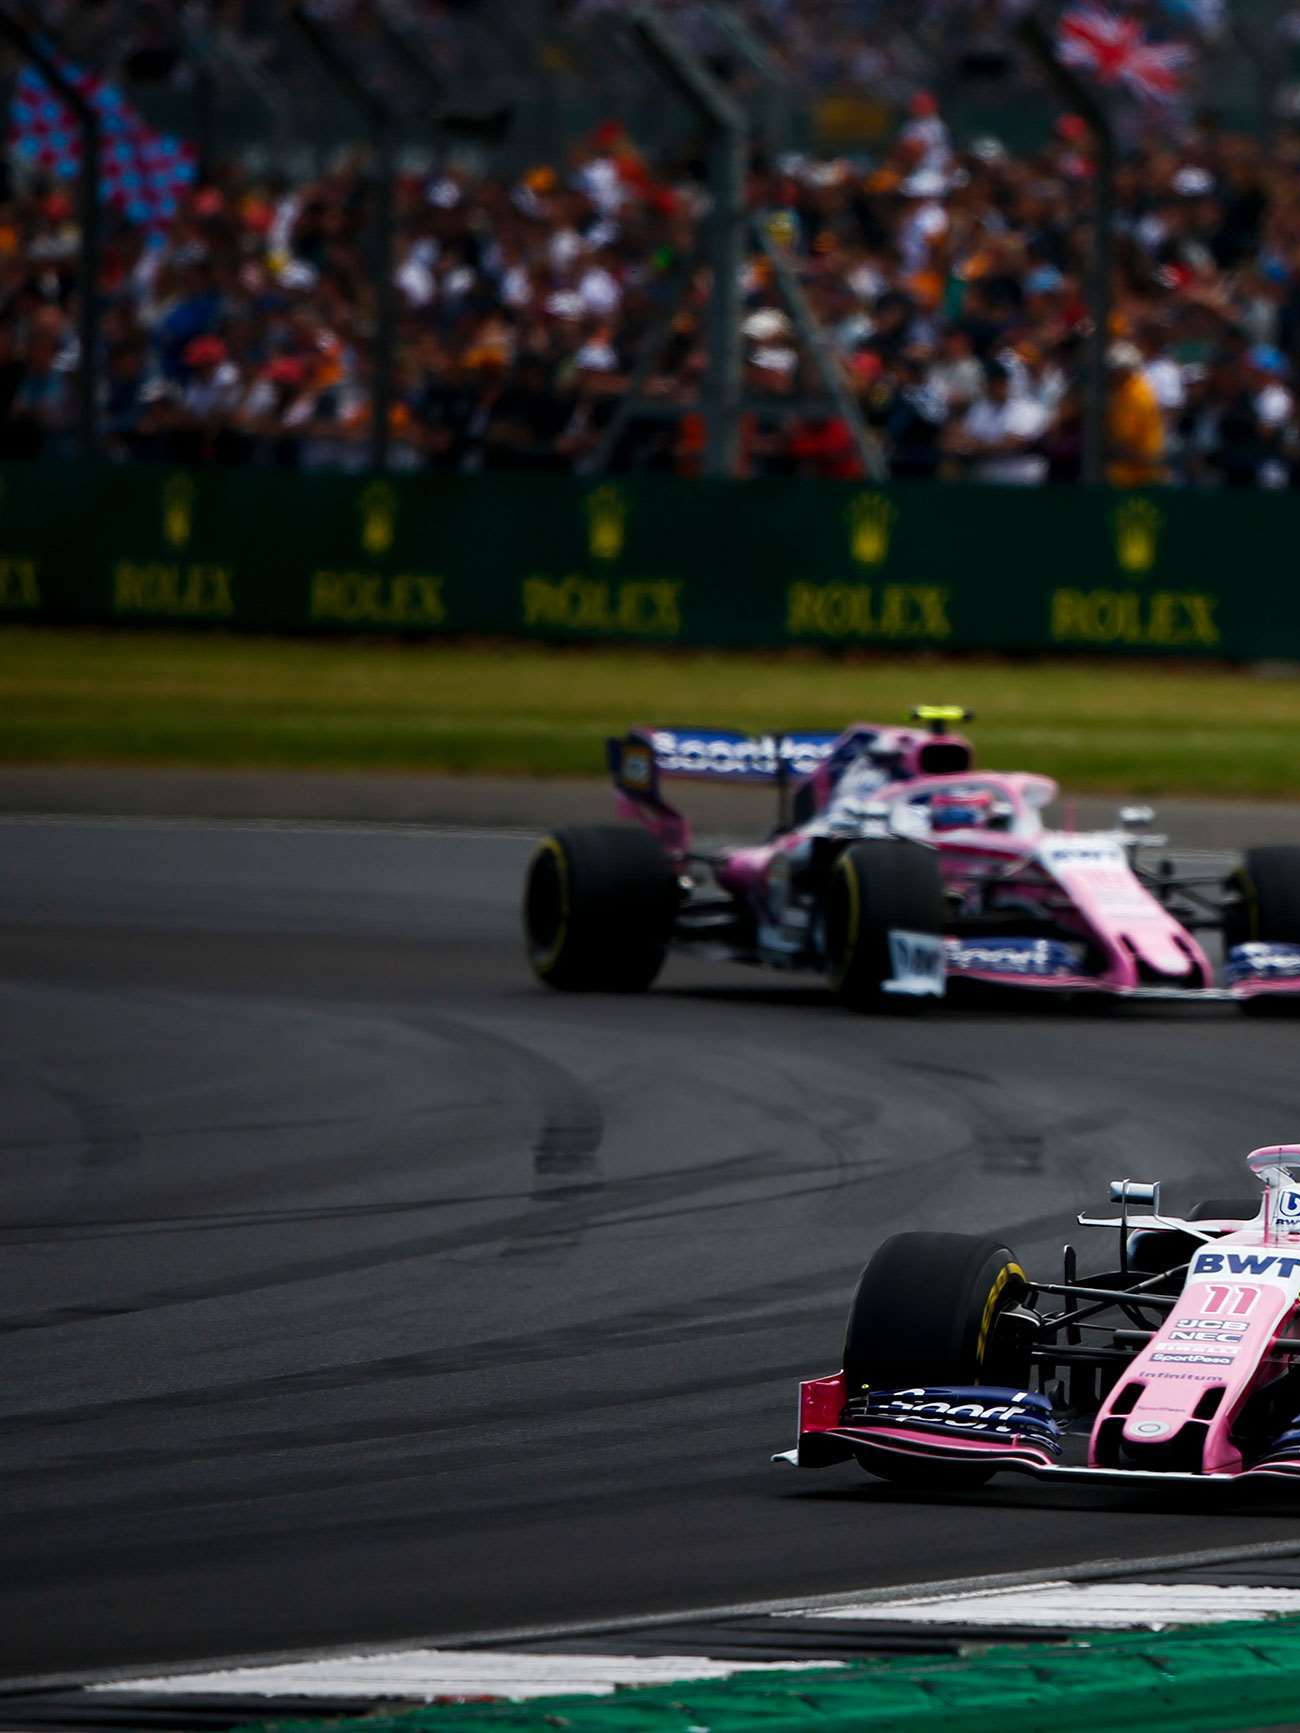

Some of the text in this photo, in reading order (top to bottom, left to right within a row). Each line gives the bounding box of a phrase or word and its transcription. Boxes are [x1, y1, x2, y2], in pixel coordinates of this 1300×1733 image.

[787, 583, 951, 637] ROLEX
[1050, 590, 1219, 643] ROLEX
[1200, 1284, 1259, 1316] 11
[1175, 1319, 1249, 1332] JCB
[1168, 1331, 1242, 1343] NEC
[1151, 1353, 1231, 1364] SportPesa
